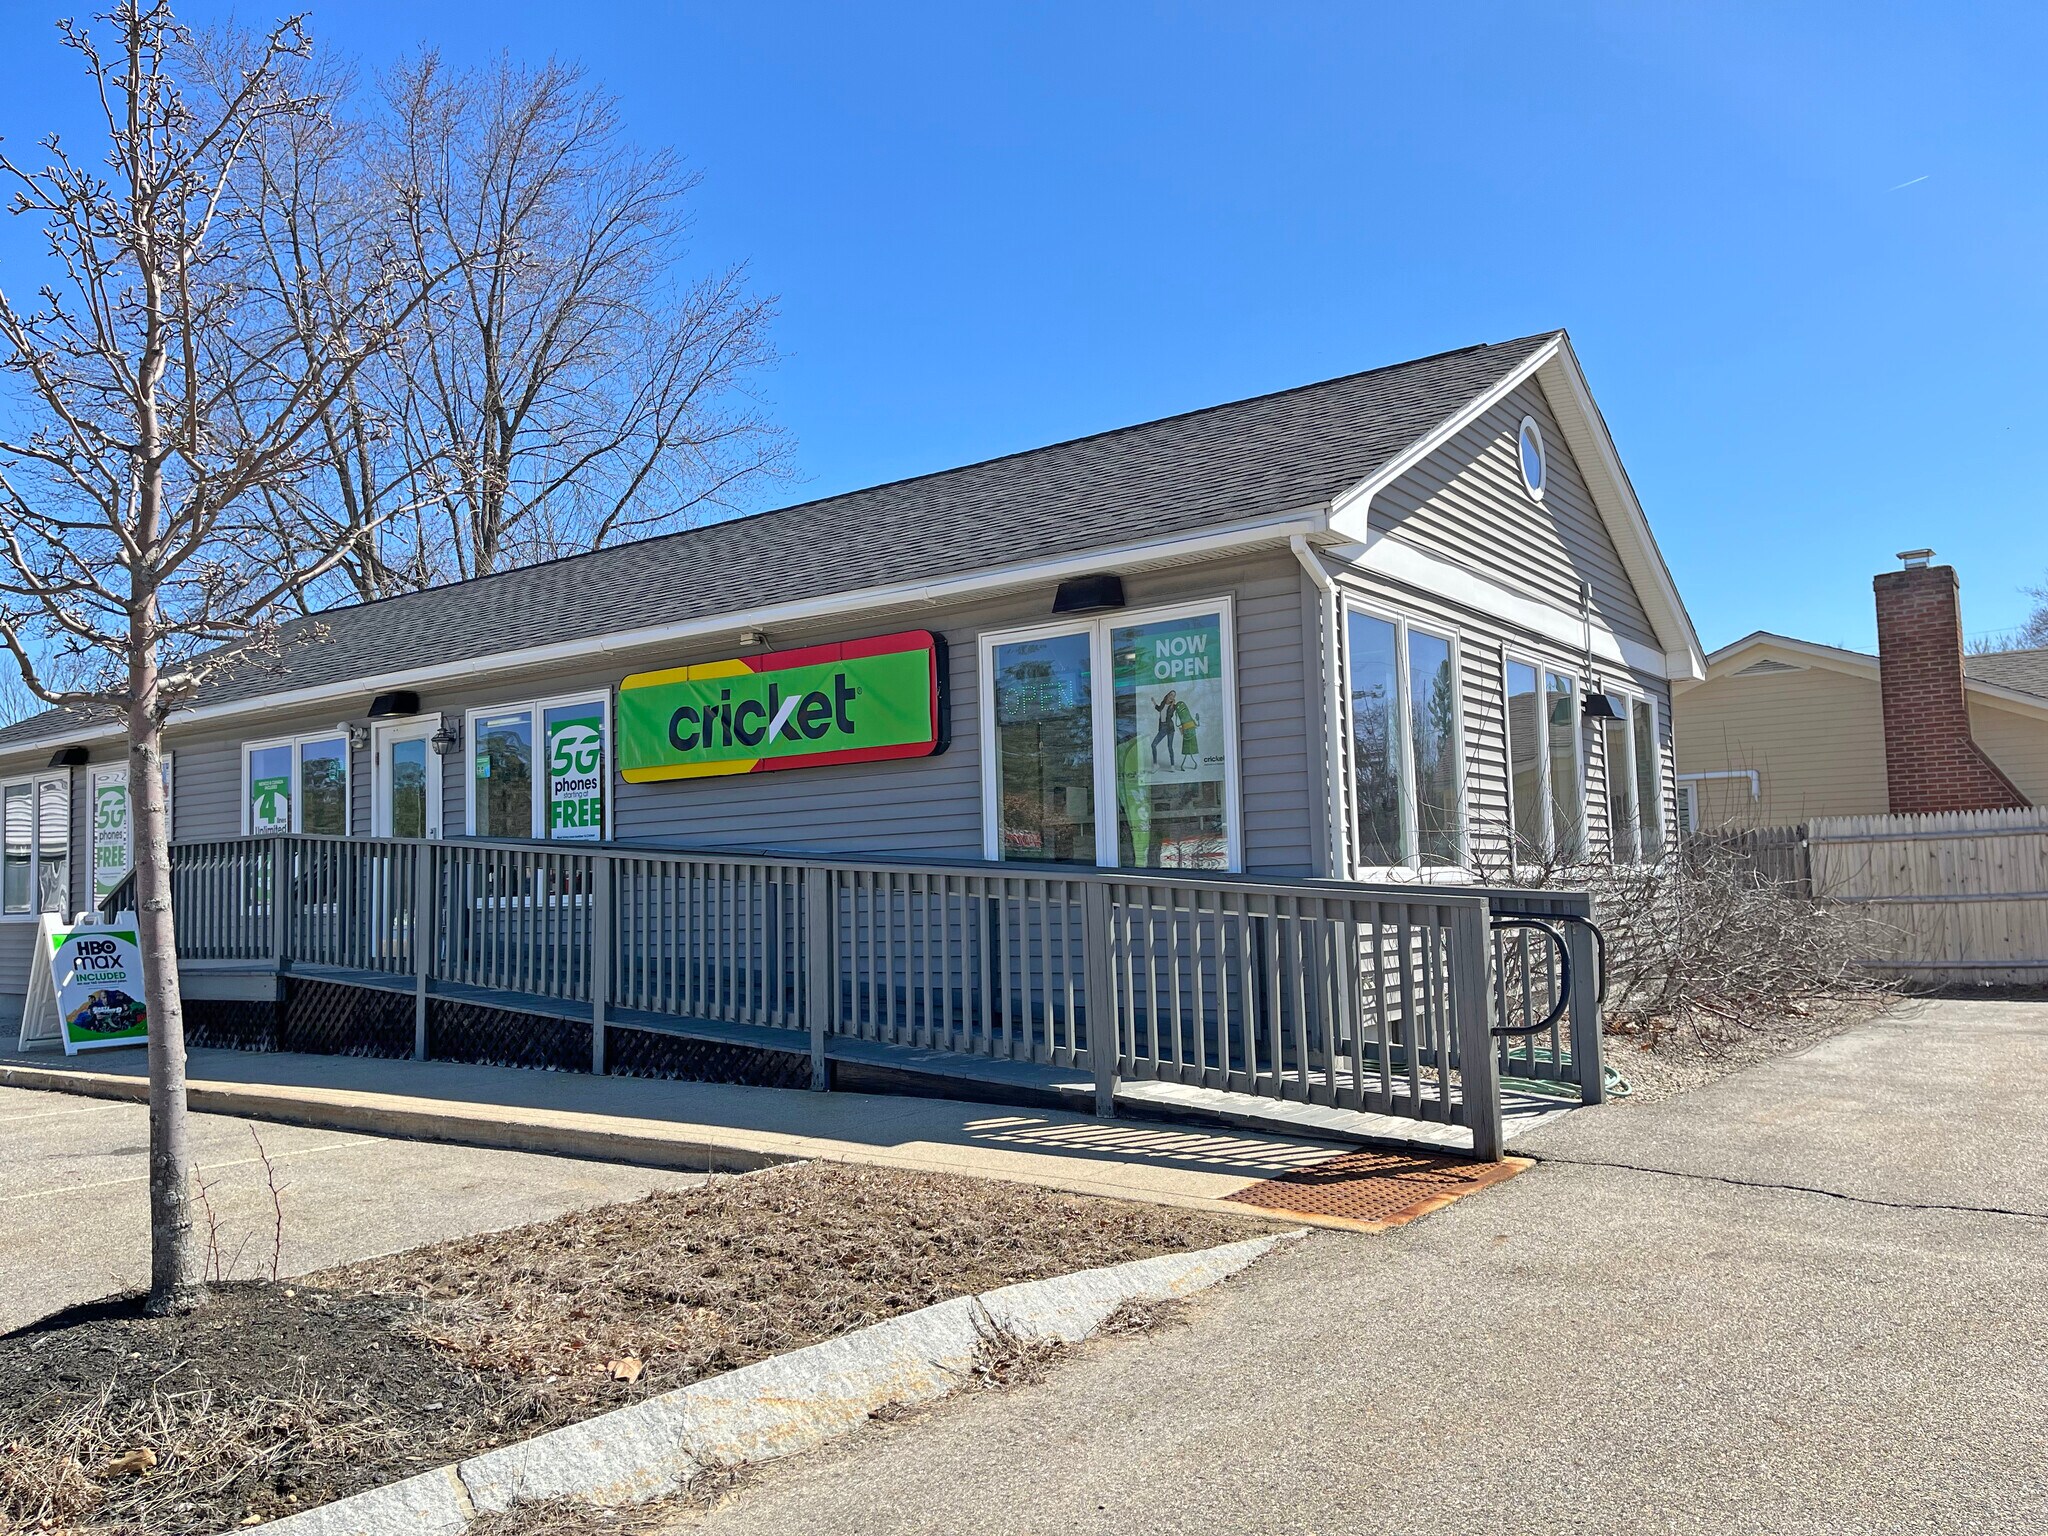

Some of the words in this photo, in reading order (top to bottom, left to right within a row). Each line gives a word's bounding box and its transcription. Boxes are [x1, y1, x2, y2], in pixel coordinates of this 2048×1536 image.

[1156, 634, 1207, 658] NOW
[1154, 656, 1209, 679] OPEN
[1005, 681, 1073, 715] OPEN
[669, 673, 856, 752] cricket
[551, 735, 600, 777] 5G
[555, 777, 598, 796] phones
[563, 790, 583, 799] starting
[97, 799, 125, 829] 5G
[259, 790, 277, 824] 4
[551, 798, 600, 829] FREE
[98, 830, 123, 843] phones
[255, 824, 287, 835] Unlimited
[96, 846, 124, 867] FREE
[76, 940, 117, 956] HBO
[73, 954, 124, 971] max
[76, 971, 127, 982] INCLUDED
